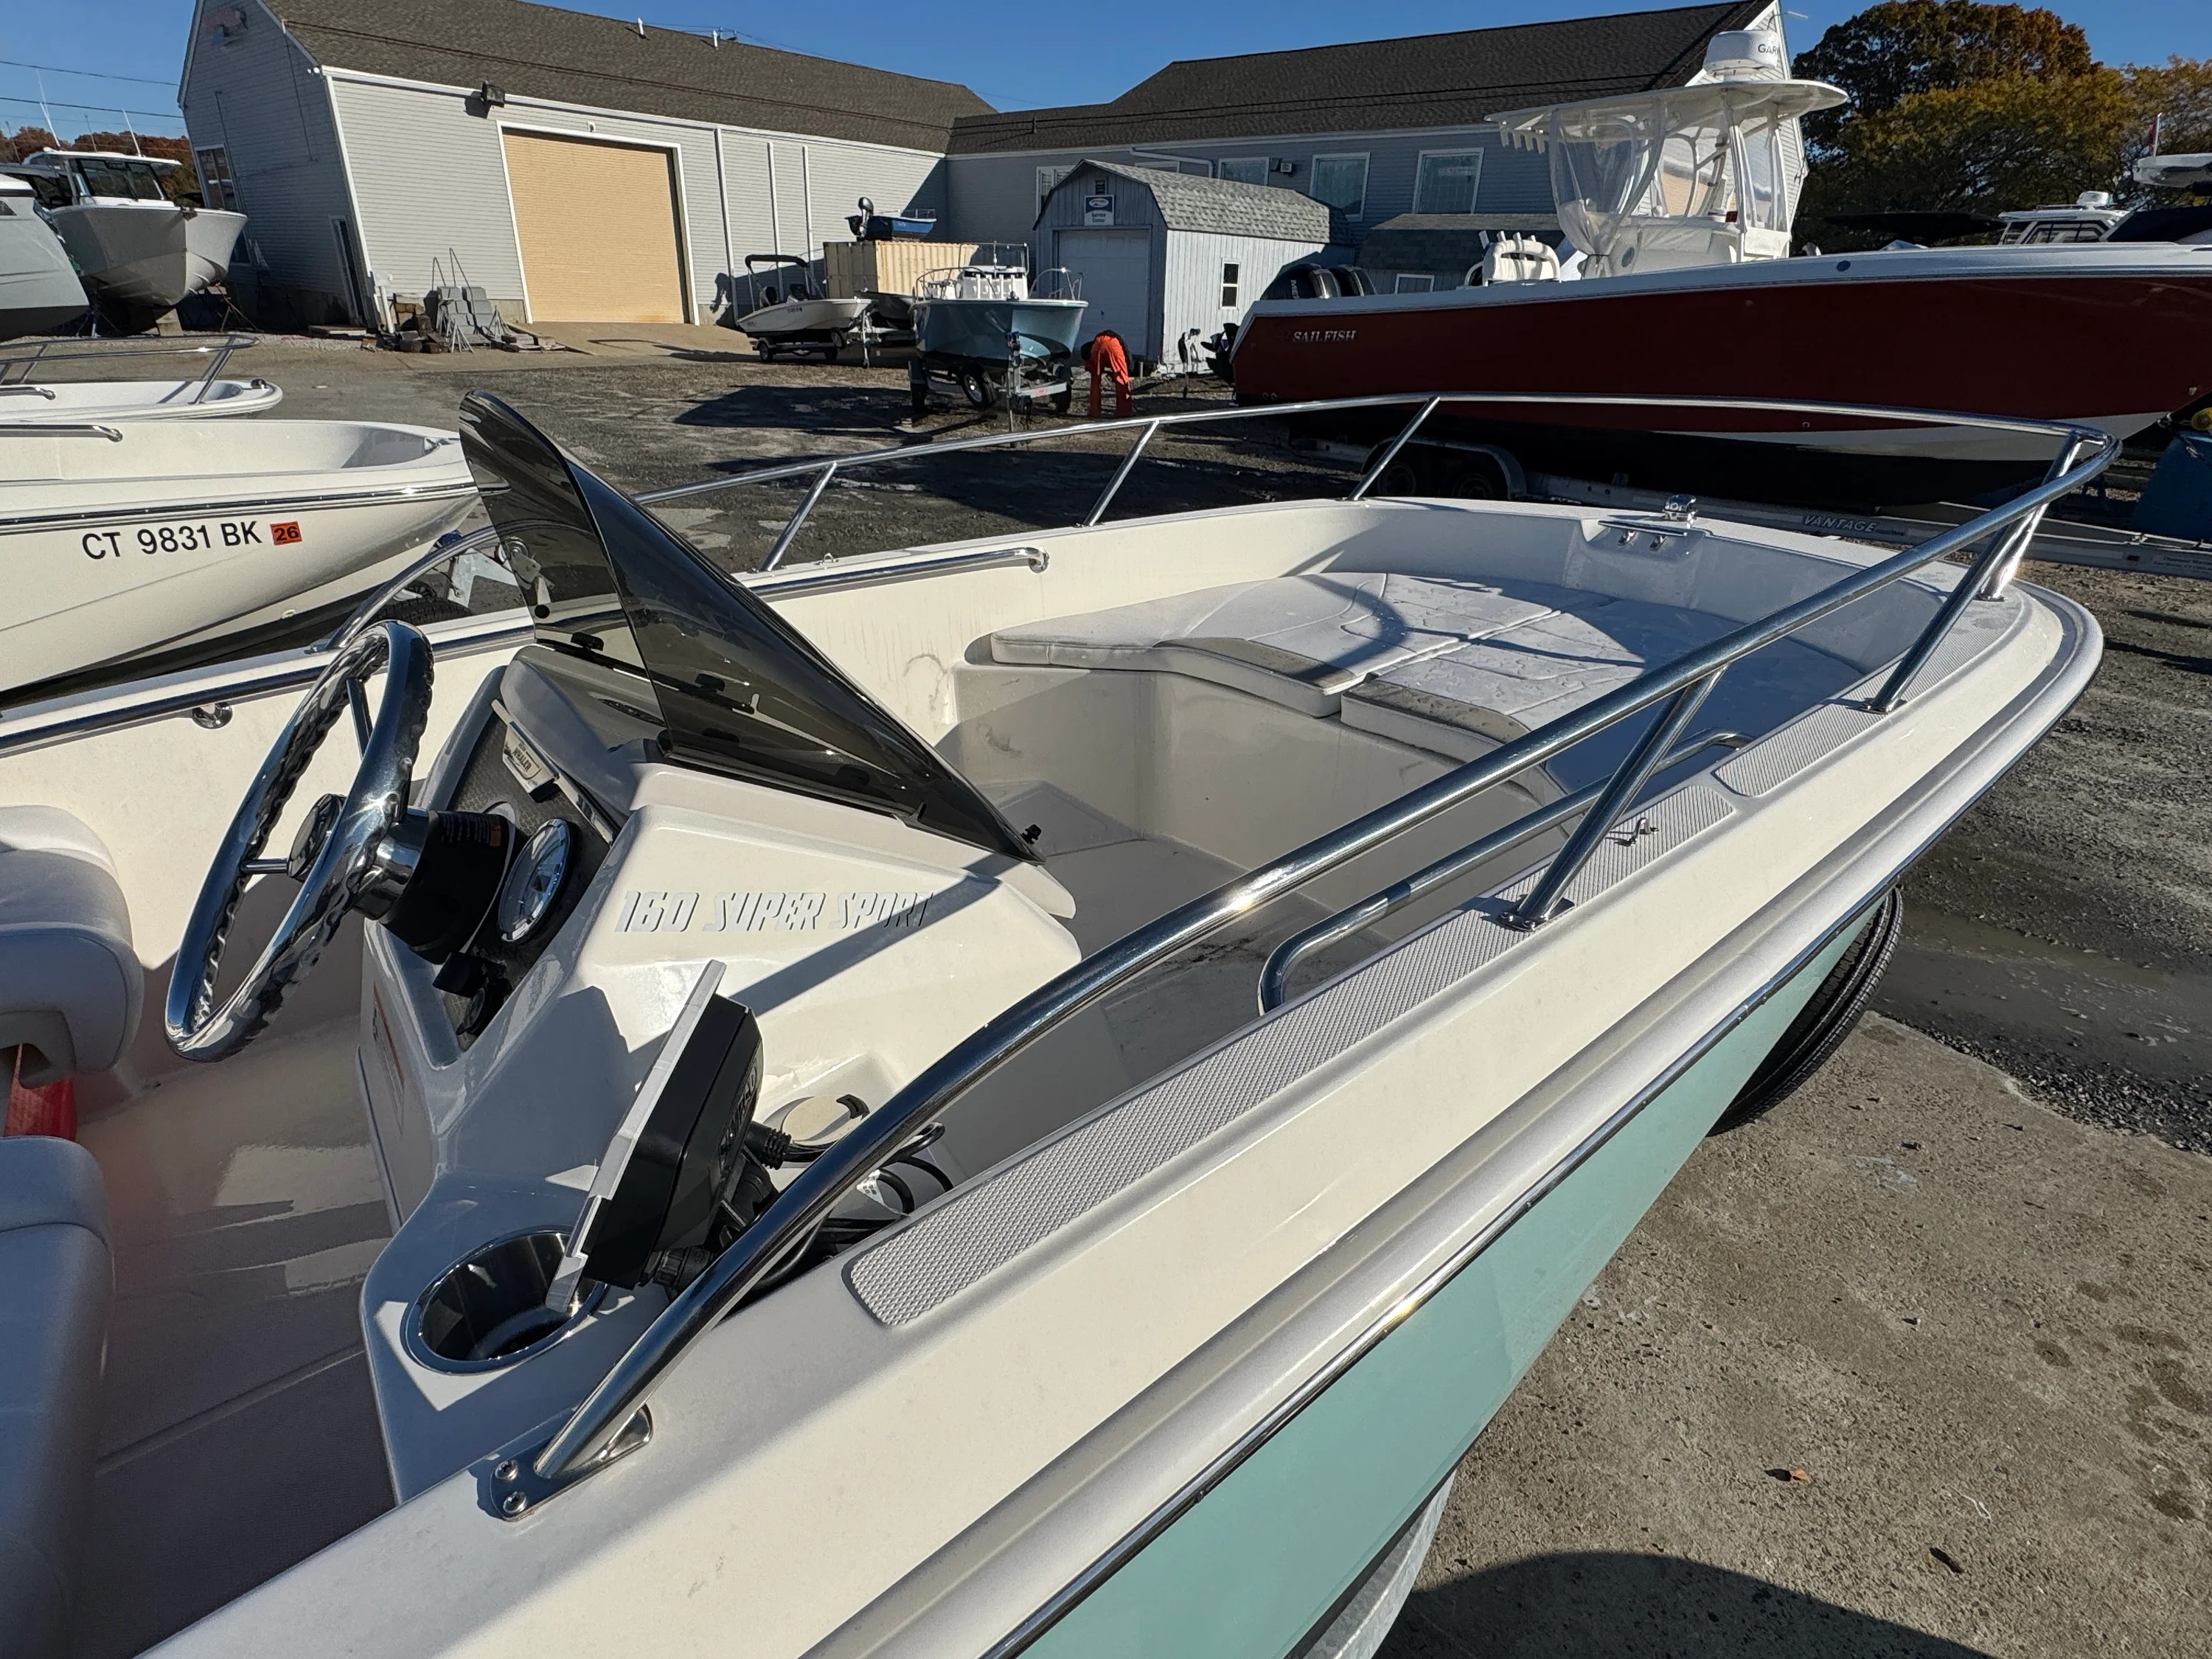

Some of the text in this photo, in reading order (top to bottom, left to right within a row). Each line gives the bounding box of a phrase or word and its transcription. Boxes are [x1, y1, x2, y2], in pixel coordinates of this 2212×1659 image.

[1293, 330, 1356, 342] SAILFISH
[1804, 515, 1878, 532] VANTAGE
[82, 521, 262, 560] CT 9831 BK
[274, 525, 299, 542] 26
[614, 891, 934, 932] 160 SUPER SPORT
